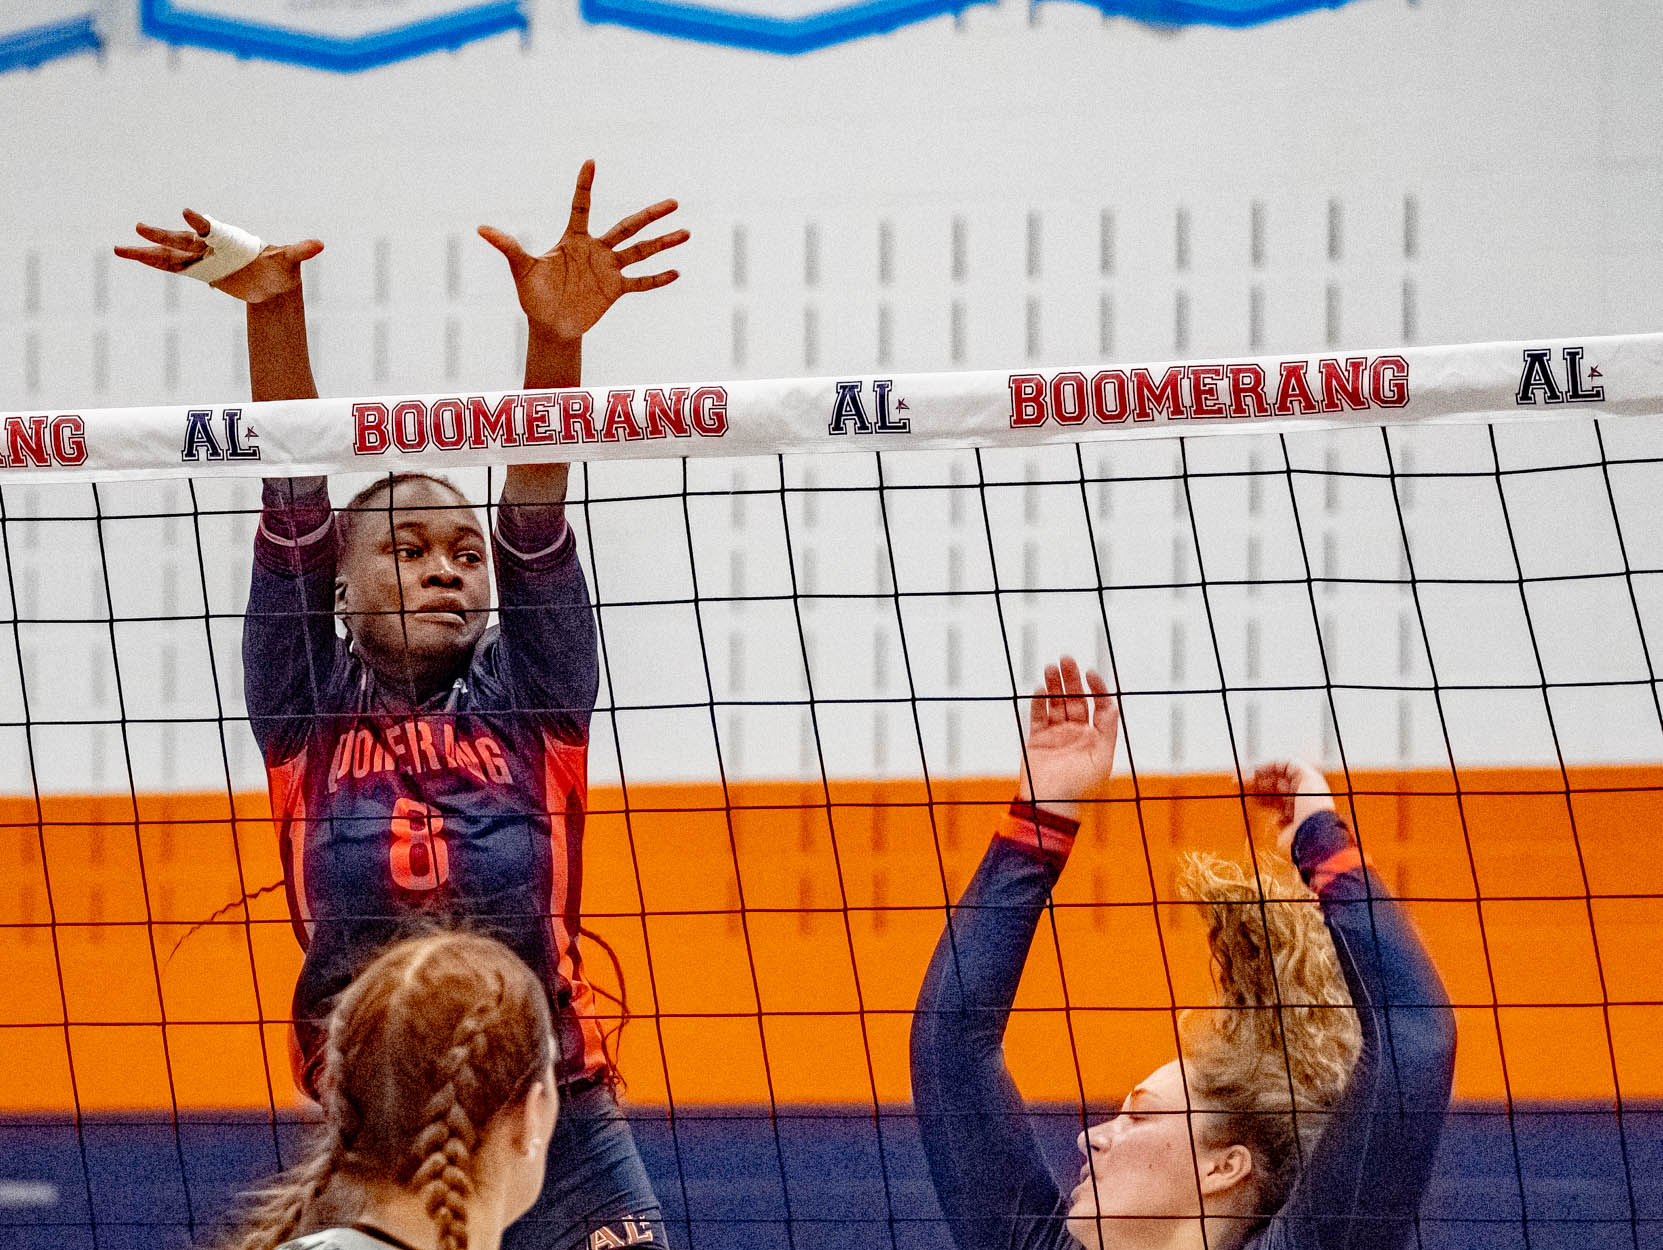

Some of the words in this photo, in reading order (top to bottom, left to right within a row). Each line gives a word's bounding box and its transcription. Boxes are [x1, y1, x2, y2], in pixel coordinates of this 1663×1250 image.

[0, 414, 89, 468] NG
[182, 409, 261, 462] AL
[352, 386, 730, 456] BOOMERANG
[828, 379, 911, 436] AL
[1008, 355, 1410, 429] BOOMERANG
[1516, 346, 1605, 405] AL
[390, 797, 449, 891] 8
